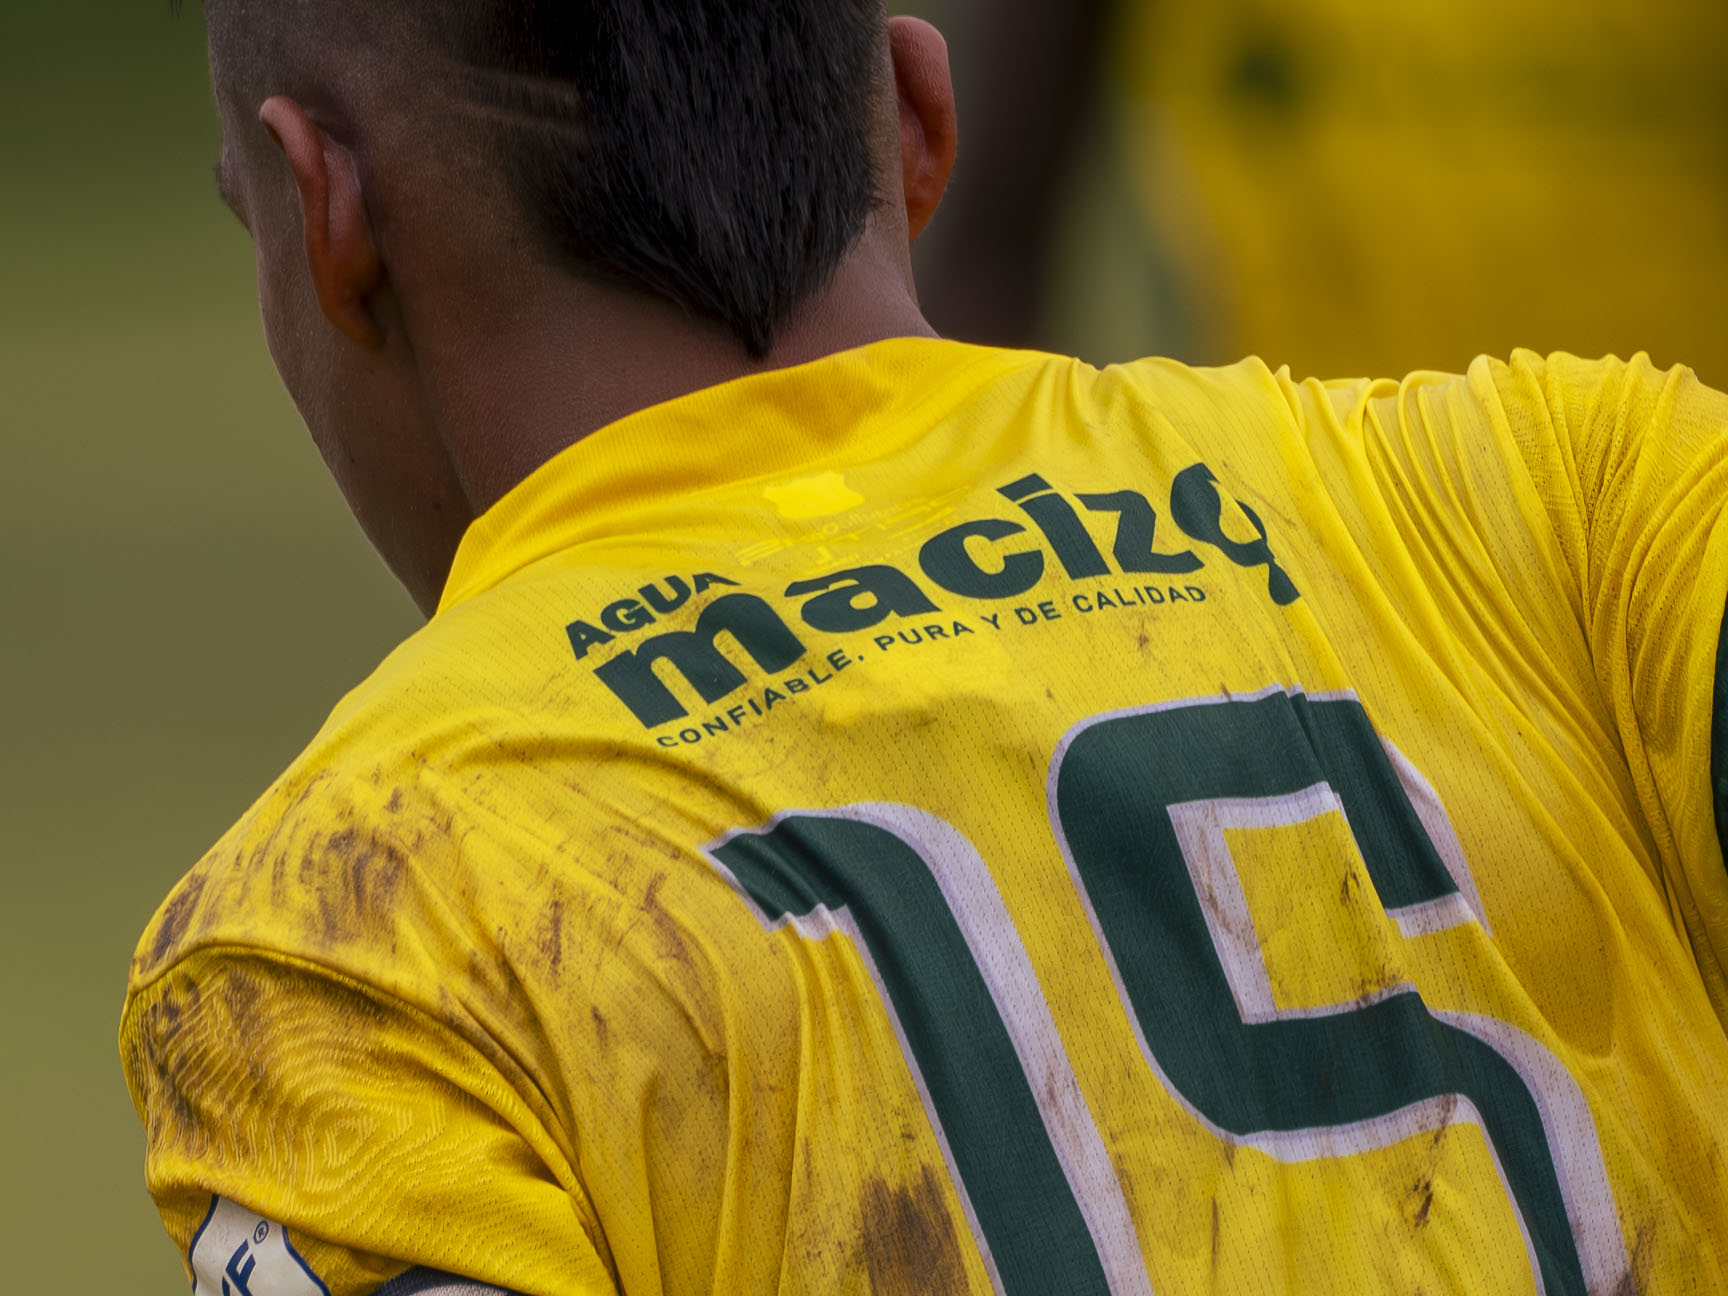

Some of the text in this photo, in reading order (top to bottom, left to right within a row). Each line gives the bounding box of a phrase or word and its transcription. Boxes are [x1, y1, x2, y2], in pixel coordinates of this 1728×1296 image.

[565, 572, 742, 661] AGUA
[873, 620, 975, 651] PURA
[980, 612, 1002, 631] Y
[1014, 601, 1062, 625] DE
[1072, 585, 1208, 613] CALIDAD
